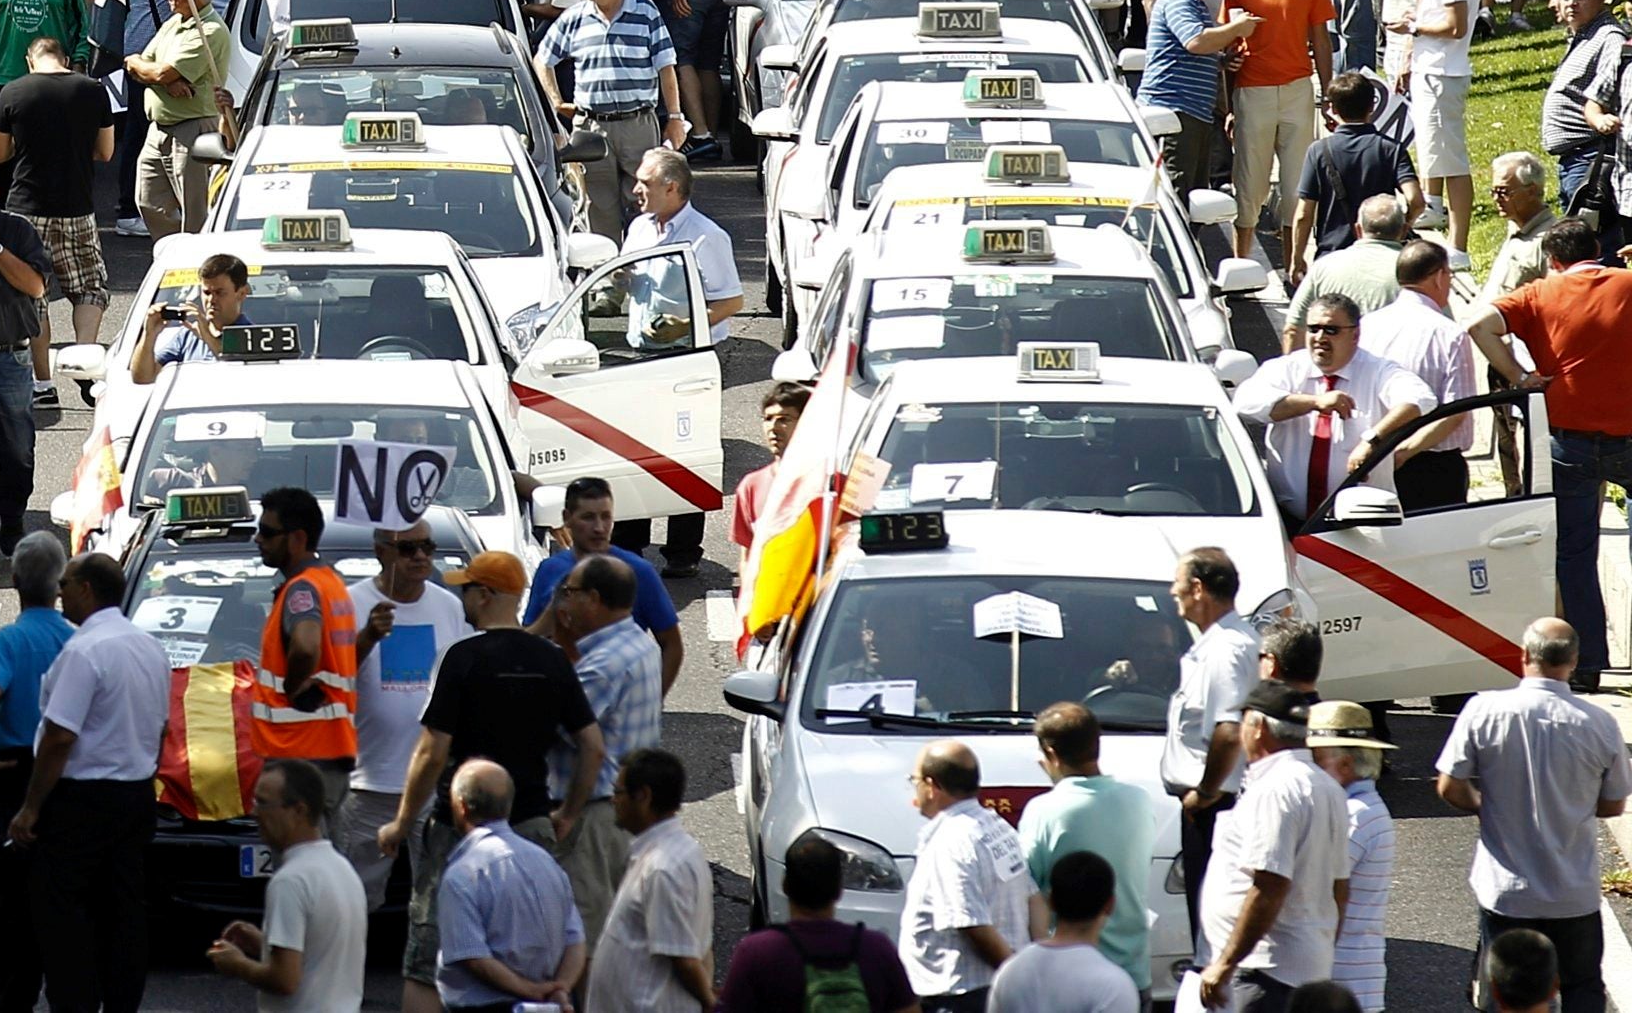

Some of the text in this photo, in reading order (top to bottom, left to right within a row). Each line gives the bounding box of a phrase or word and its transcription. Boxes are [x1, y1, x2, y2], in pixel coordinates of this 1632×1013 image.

[937, 11, 982, 29] TAXI
[302, 25, 335, 43] TAXI
[982, 78, 1017, 98] TAXI
[361, 121, 398, 141] TAXI
[899, 127, 928, 139] 30
[1004, 154, 1041, 175] TAXI
[263, 179, 290, 192] 22
[914, 212, 941, 225] 21
[281, 219, 322, 241] TAXI
[985, 232, 1024, 252] TAXI
[899, 287, 927, 302] 15
[242, 325, 296, 350] 123
[1034, 349, 1073, 370] TAXI
[206, 420, 227, 436] 9
[338, 445, 450, 523] NO
[942, 474, 965, 496] 7
[182, 496, 225, 516] TAXI
[159, 606, 187, 630] 3
